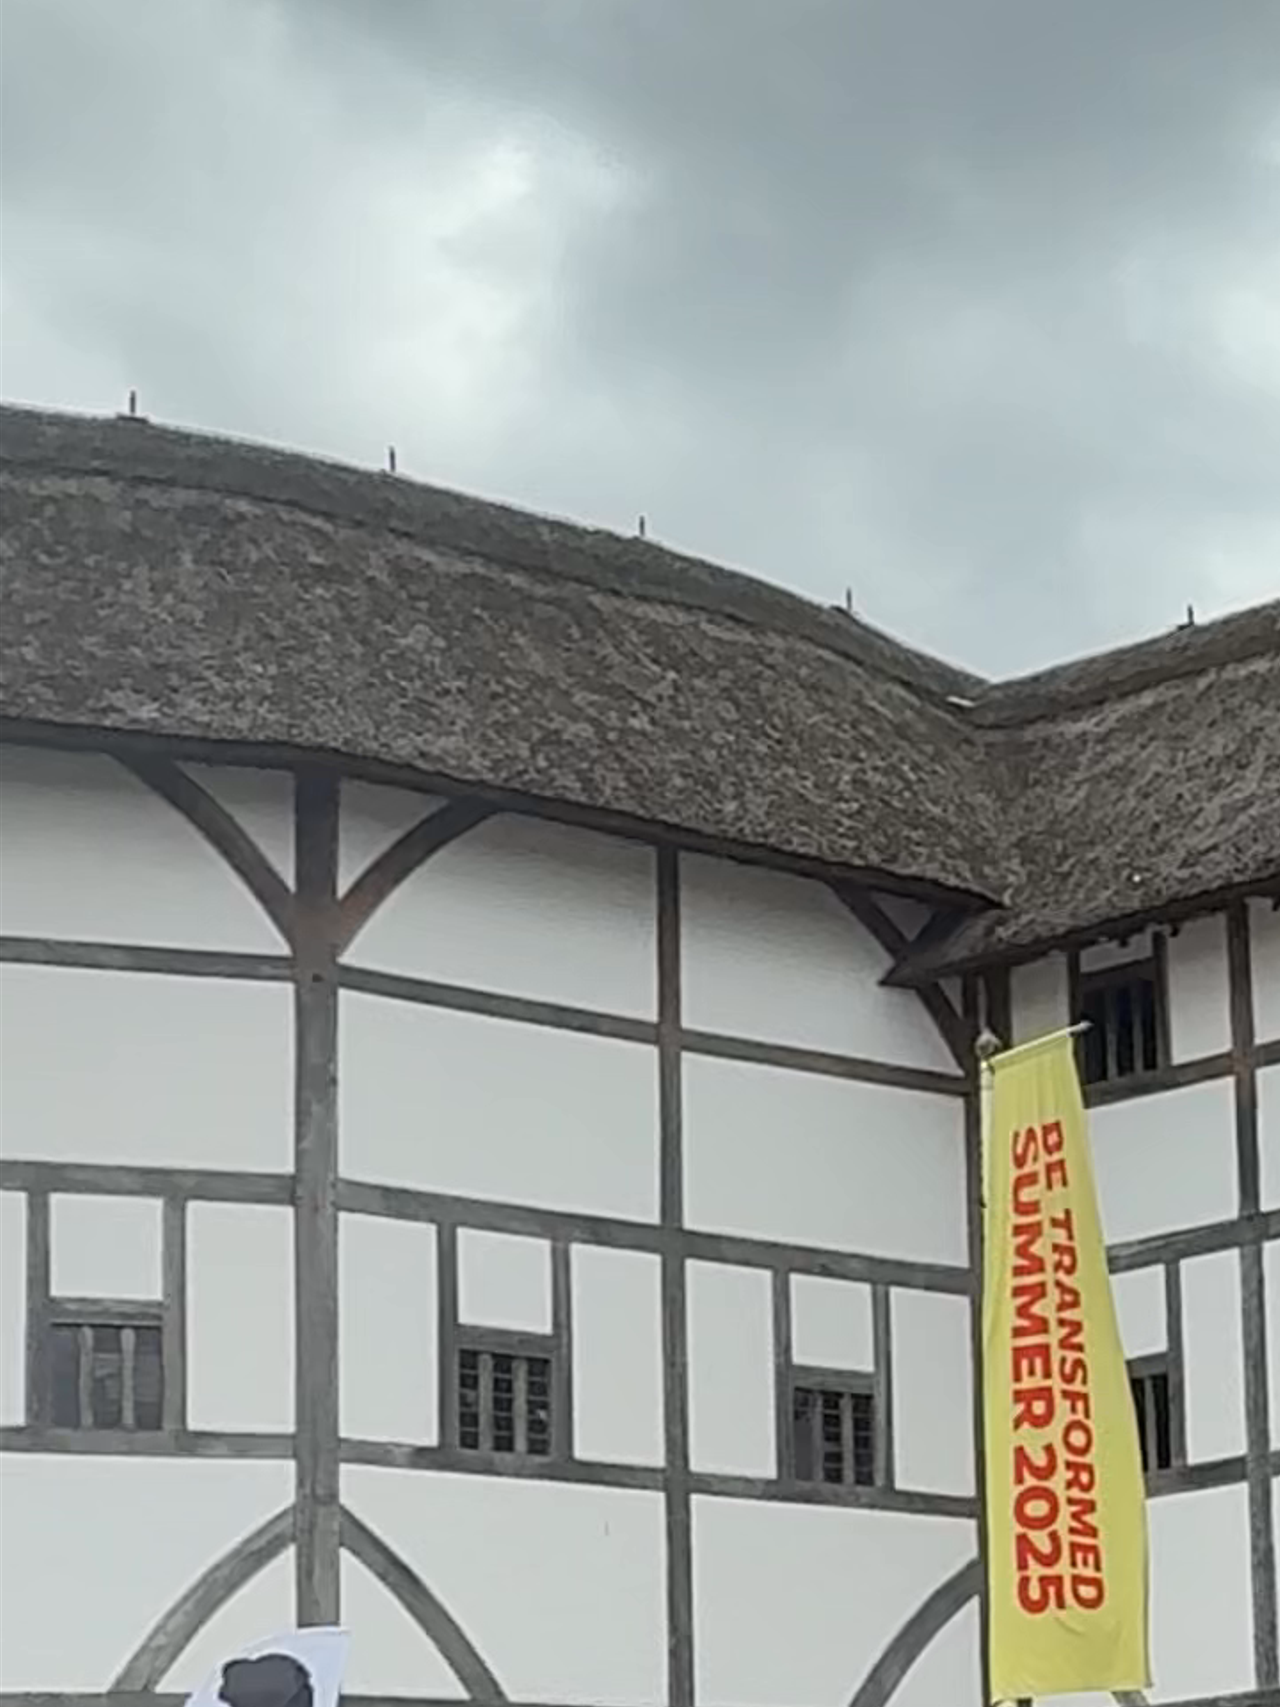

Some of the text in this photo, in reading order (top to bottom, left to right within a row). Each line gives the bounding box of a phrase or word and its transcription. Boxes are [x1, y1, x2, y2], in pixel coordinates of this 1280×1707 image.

[1010, 1126, 1067, 1614] SUMMER 2025
[1041, 1120, 1105, 1610] BE TRANSFORMED
